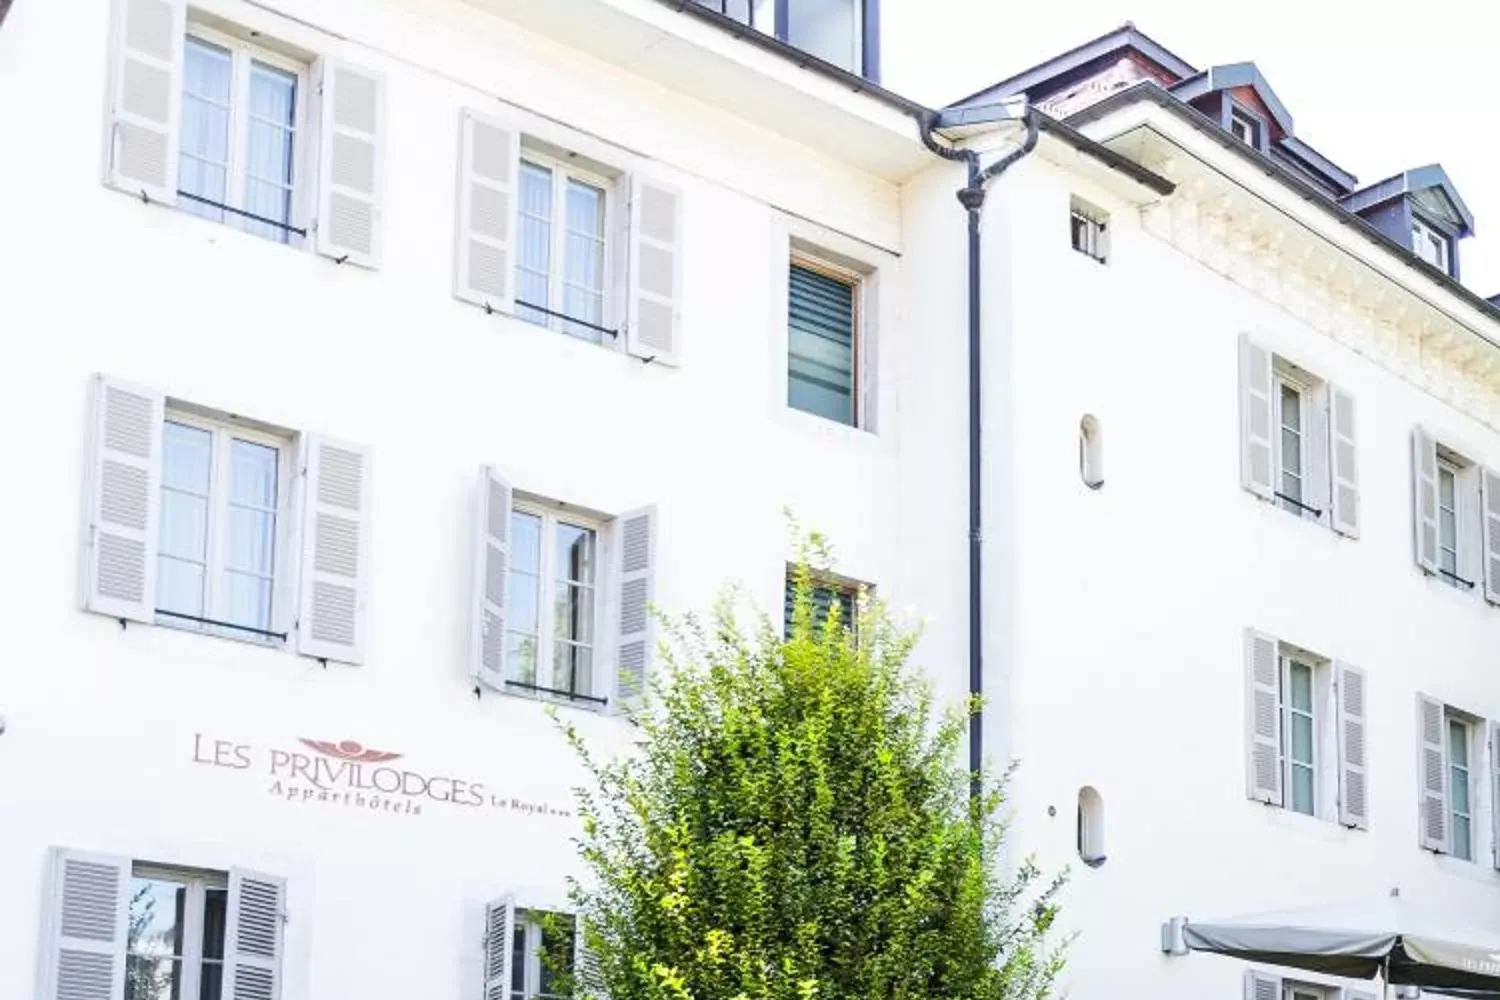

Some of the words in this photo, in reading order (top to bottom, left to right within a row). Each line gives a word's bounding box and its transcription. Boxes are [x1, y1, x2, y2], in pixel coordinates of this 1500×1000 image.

[193, 733, 251, 769] LES
[269, 748, 484, 807] PRIVILODGES
[511, 798, 548, 816] Royal
